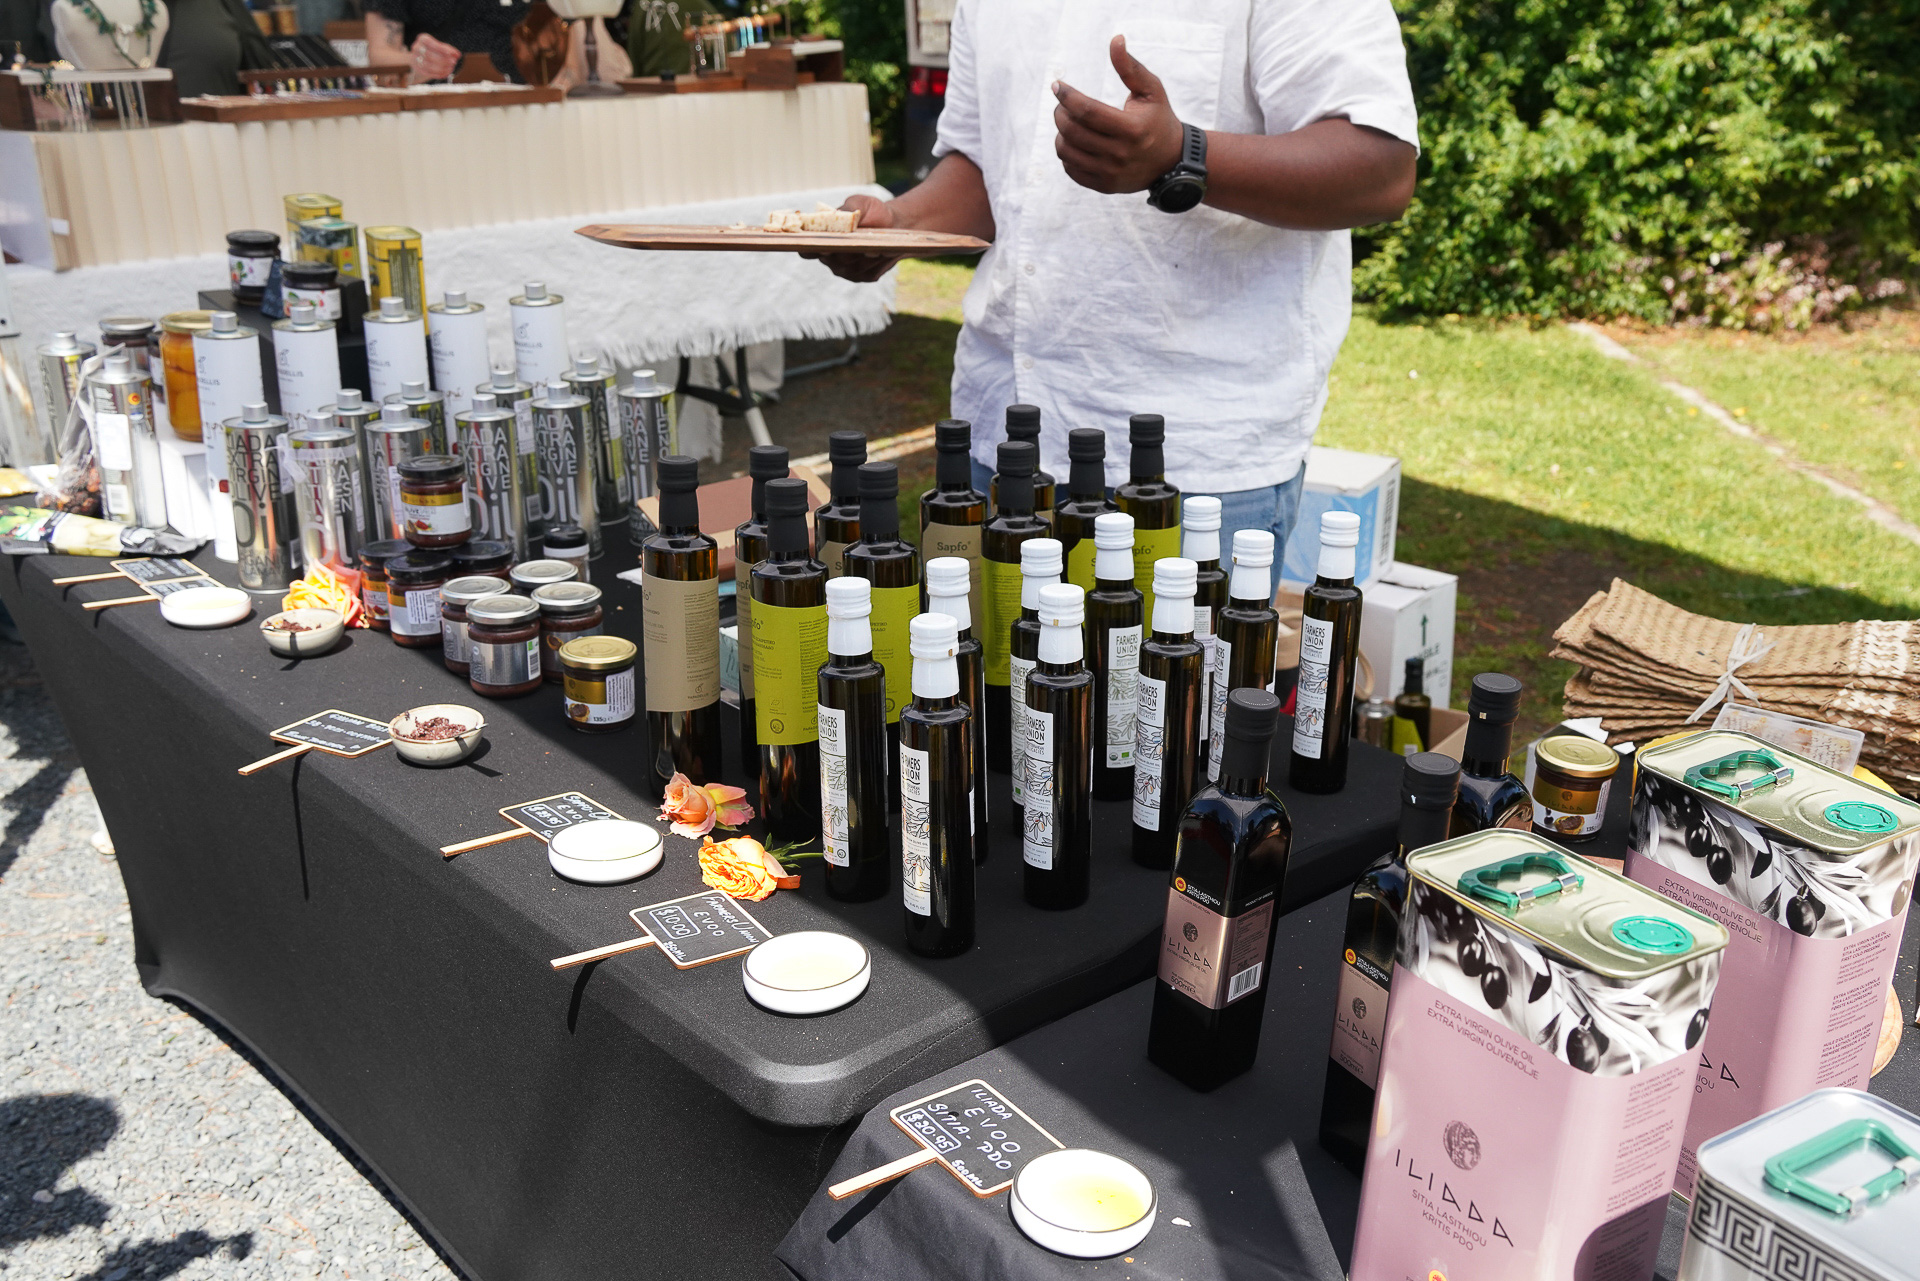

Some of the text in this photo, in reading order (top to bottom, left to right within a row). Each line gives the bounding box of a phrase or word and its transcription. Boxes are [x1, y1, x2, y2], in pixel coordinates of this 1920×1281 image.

[937, 541, 968, 554] Sapfo
[1132, 545, 1152, 557] pfo
[1116, 634, 1139, 645] FARMERS
[1305, 624, 1326, 639] FARMERS
[1305, 635, 1324, 647] UNION
[1116, 645, 1138, 655] UNION
[1139, 681, 1158, 699] FARMERS
[1139, 695, 1157, 708] UNION
[818, 712, 838, 729] FARMERS
[1025, 714, 1046, 731] FARMERS
[819, 726, 838, 738] UNION
[1025, 727, 1046, 742] UNION
[901, 752, 921, 771] FARMERS
[901, 764, 921, 781] UNION
[702, 894, 739, 924] FARMERS
[1658, 885, 1763, 944] EXTRA VIRGIN OLIVENOLJE
[1664, 878, 1759, 932] EXTRA VIRGIN OLIVE OIL
[1163, 933, 1213, 970] ILIADA
[1338, 1012, 1380, 1051] LIADA
[1435, 999, 1535, 1065] EXTRA VIRGIN OLIVE OIL
[1427, 1007, 1540, 1081] EXTRA VIRGIN OLIVENOLJE
[971, 1088, 1013, 1121] ILIADA
[907, 1112, 954, 1151] $20.95
[976, 1141, 1012, 1170] PDO
[1395, 1149, 1514, 1248] ILIADA
[1411, 1189, 1487, 1247] SITIA LASITHIOU
[1422, 1210, 1474, 1251] KRITIS PDO
